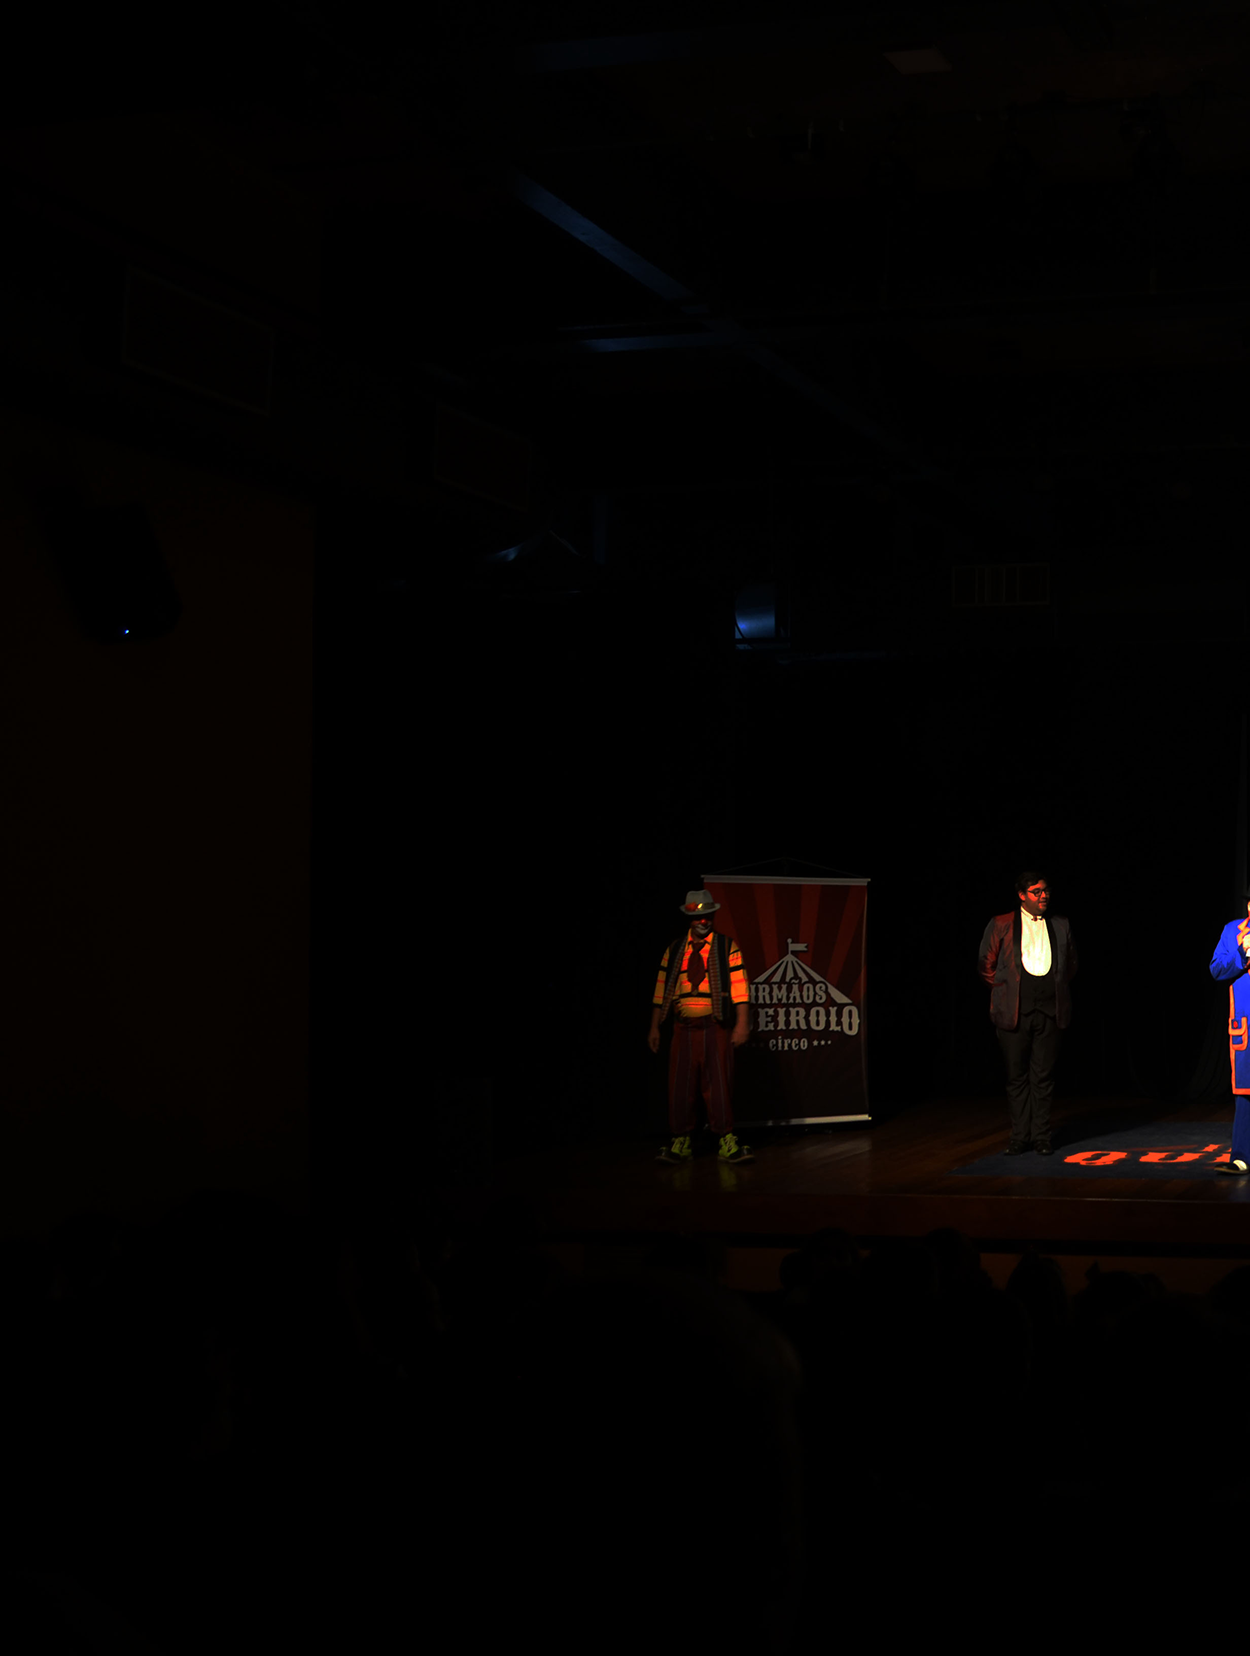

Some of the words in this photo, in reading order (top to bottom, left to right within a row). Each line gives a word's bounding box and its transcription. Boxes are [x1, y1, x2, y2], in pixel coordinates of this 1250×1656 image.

[750, 979, 827, 1005] IRMÃOS
[750, 1005, 861, 1036] EIROLO
[768, 1035, 809, 1051] circo
